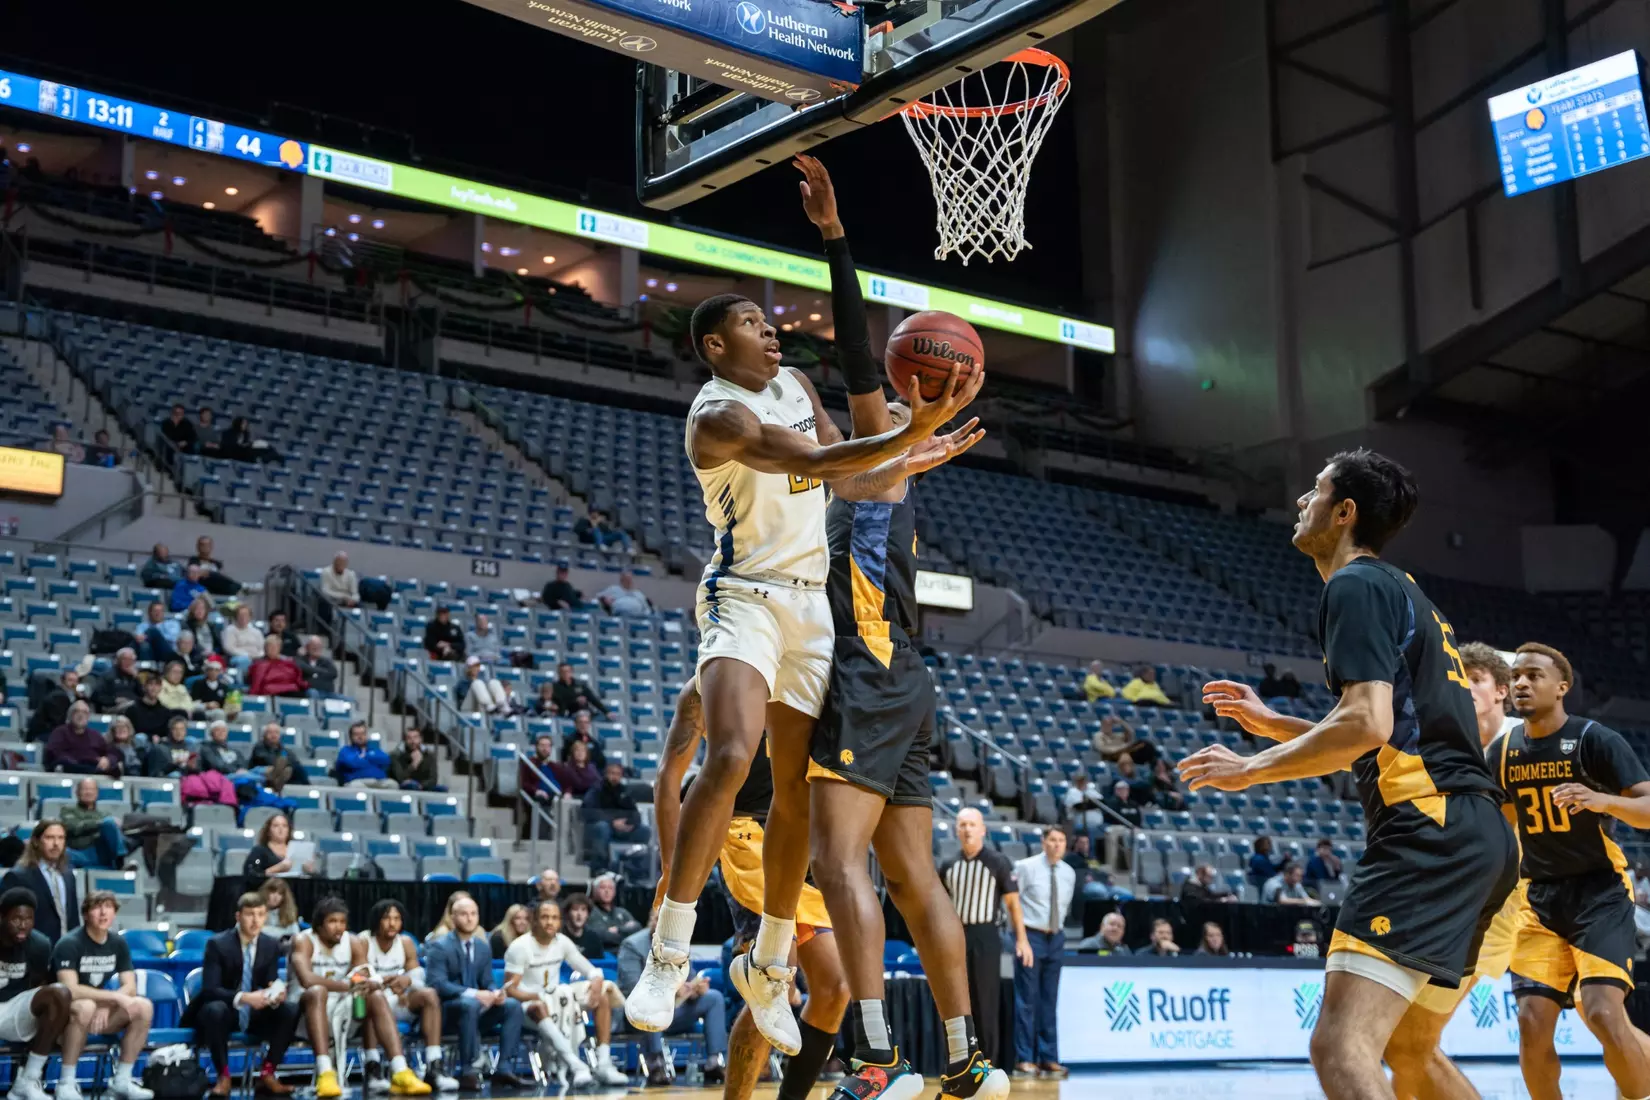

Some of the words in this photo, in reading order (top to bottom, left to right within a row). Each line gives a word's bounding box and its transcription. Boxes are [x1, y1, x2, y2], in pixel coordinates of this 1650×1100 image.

[527, 0, 585, 24] Network
[548, 17, 617, 43] Lutheran
[584, 19, 628, 38] Health
[767, 10, 828, 39] Lutheran
[768, 26, 806, 49] Health
[807, 38, 855, 62] Network
[704, 57, 755, 79] Network
[0, 78, 11, 98] 6
[721, 71, 784, 94] Lutheran
[755, 74, 796, 89] Health
[87, 97, 133, 128] 13:11
[158, 111, 169, 127] 2
[236, 134, 262, 157] 44
[912, 337, 975, 369] Wilson
[474, 560, 497, 576] 216
[1508, 760, 1574, 783] COMMERCE
[1517, 786, 1572, 835] 30
[1148, 988, 1231, 1022] Ruoff
[1150, 1029, 1236, 1049] MORTGAGE
